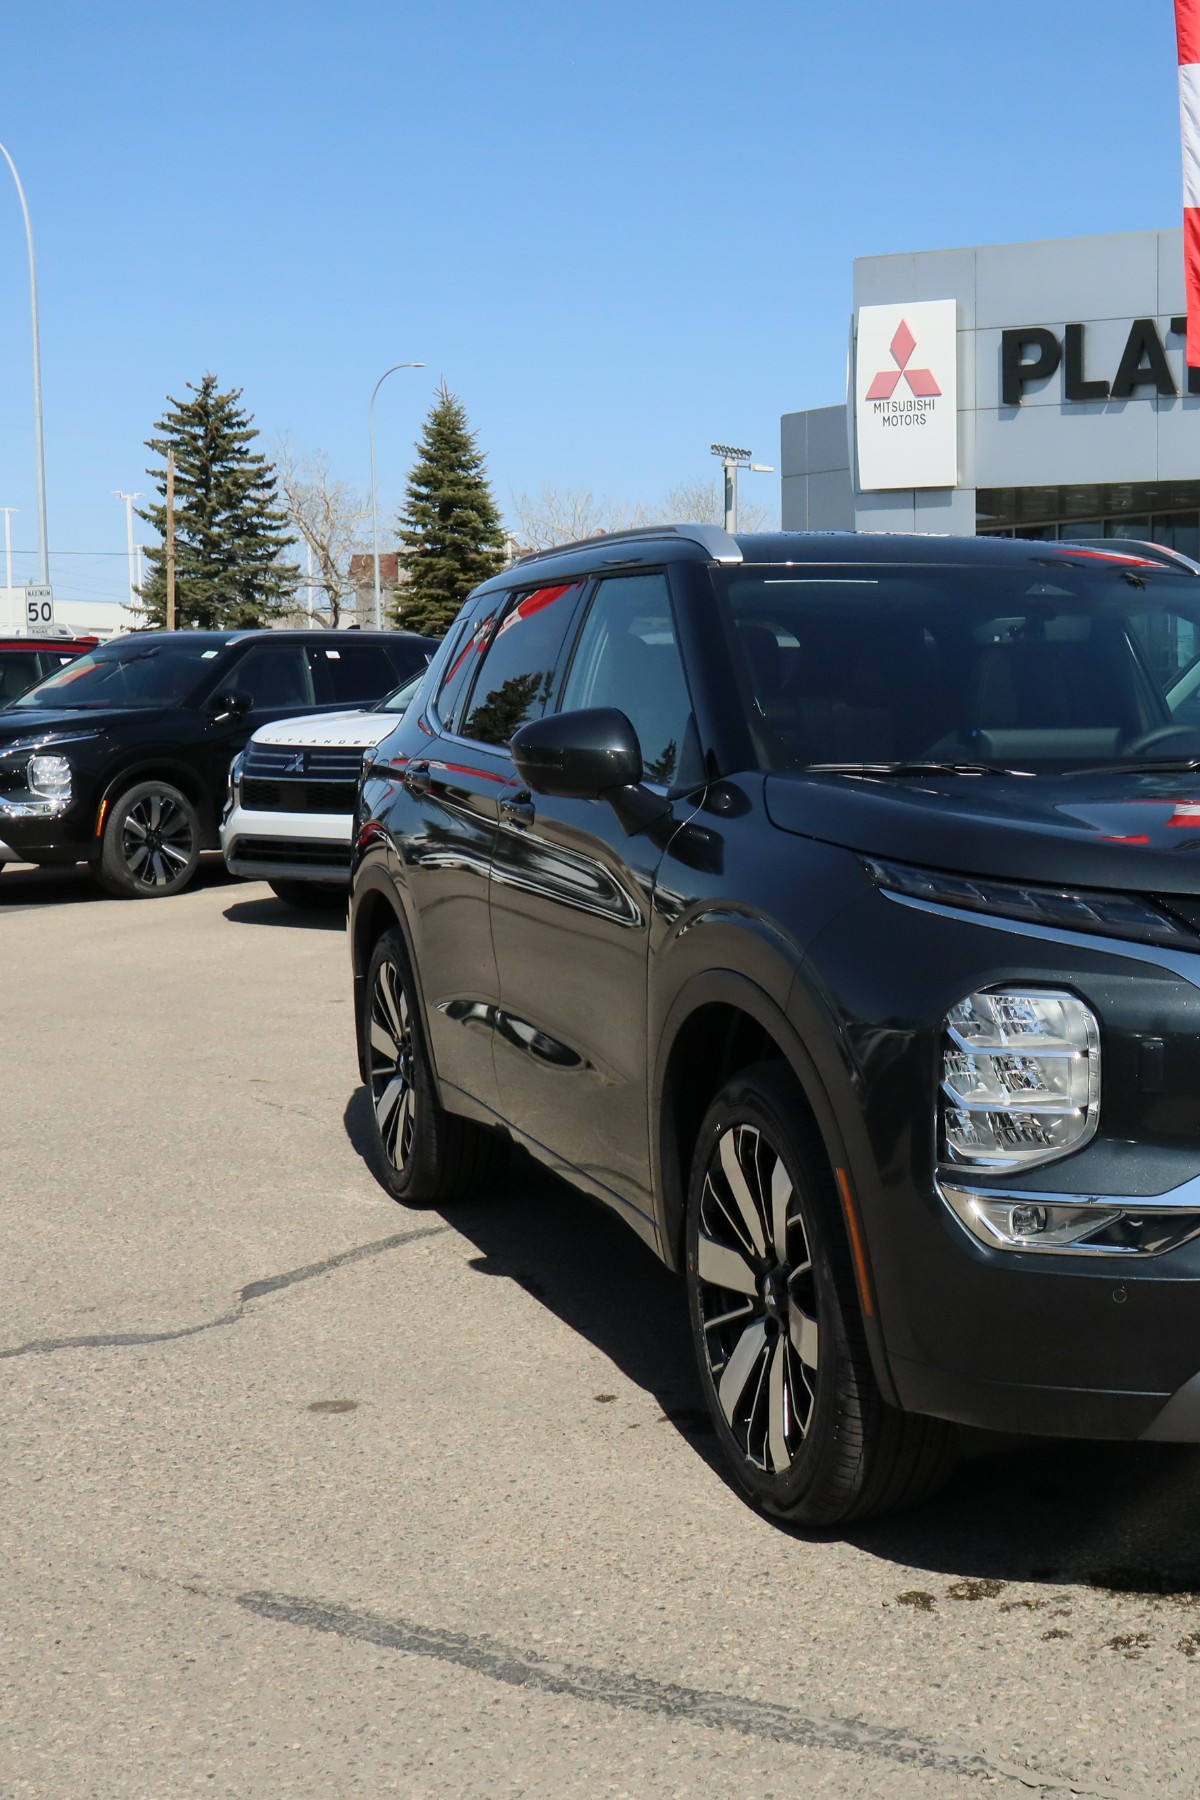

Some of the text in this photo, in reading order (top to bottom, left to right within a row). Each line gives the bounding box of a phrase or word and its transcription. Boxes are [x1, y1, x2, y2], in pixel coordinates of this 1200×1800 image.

[873, 399, 935, 414] MITSUBISHI
[882, 413, 927, 427] MOTORS
[28, 602, 52, 622] 50
